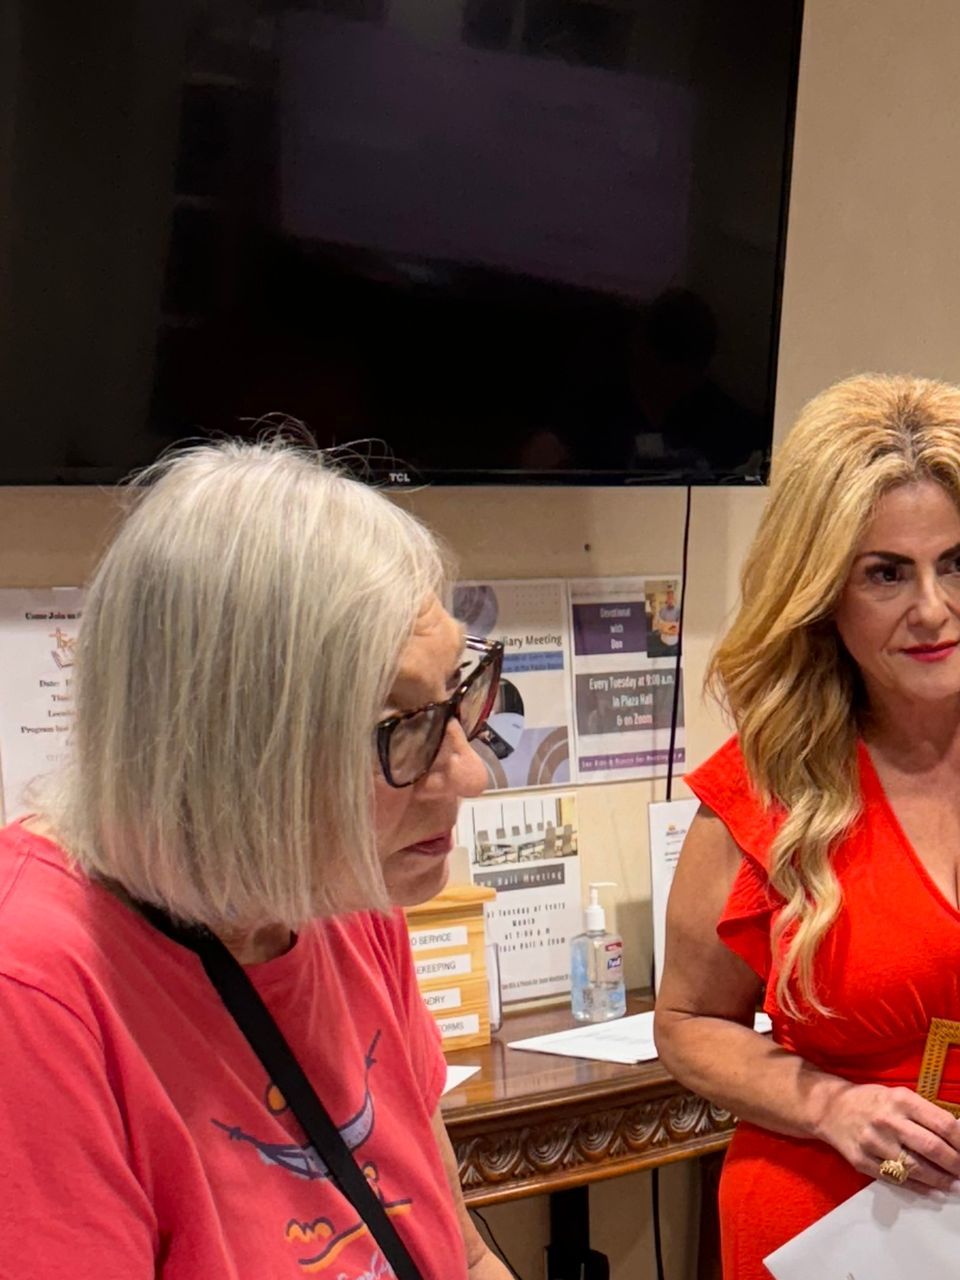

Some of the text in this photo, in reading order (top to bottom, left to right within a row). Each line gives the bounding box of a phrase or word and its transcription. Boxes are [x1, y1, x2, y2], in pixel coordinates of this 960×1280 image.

[389, 473, 410, 482] TCL
[48, 612, 65, 620] Join
[525, 633, 562, 646] Meeting
[589, 678, 608, 692] Every
[610, 676, 637, 690] Tuesday
[638, 676, 645, 686] at
[523, 871, 562, 883] Meeting
[419, 933, 451, 946] SERVICE
[440, 1022, 464, 1032] ORMS
